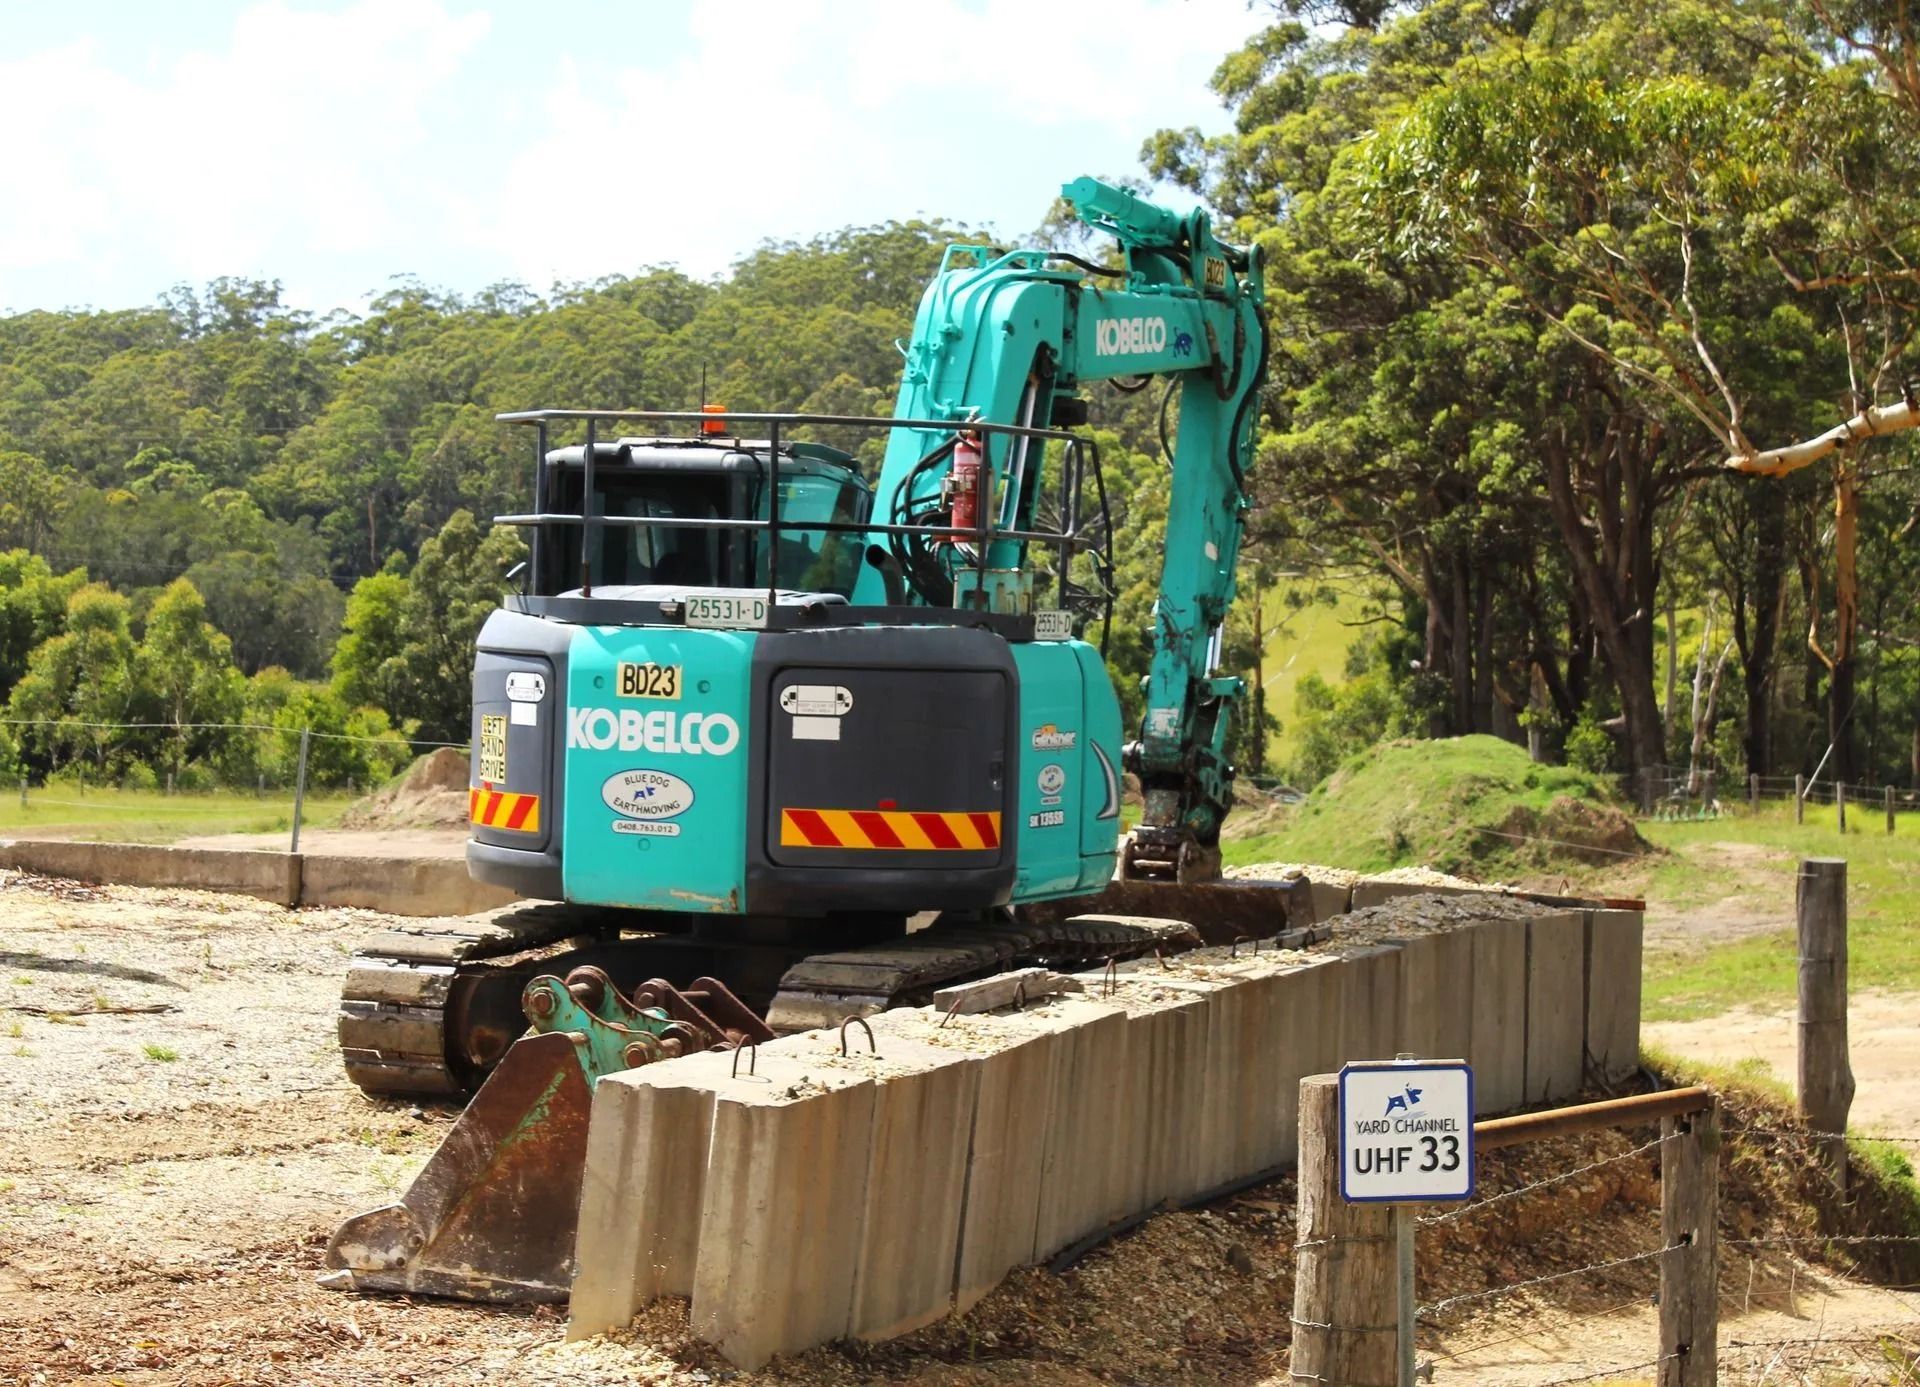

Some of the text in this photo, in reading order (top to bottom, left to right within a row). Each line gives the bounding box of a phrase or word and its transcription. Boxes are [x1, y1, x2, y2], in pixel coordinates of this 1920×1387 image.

[1096, 316, 1166, 356] KOBELCO
[623, 664, 675, 697] BD23
[483, 717, 505, 735] LEFT
[567, 706, 740, 756] KOBELCO
[481, 737, 504, 757] HAND
[480, 759, 504, 779] DRIVE
[624, 774, 670, 788] BLUE DOG
[613, 797, 680, 815] EARTHMOVING
[617, 822, 673, 833] 0408.763.012
[1355, 1118, 1460, 1134] YARD CHANNEL
[1354, 1135, 1460, 1175] UHF 33
